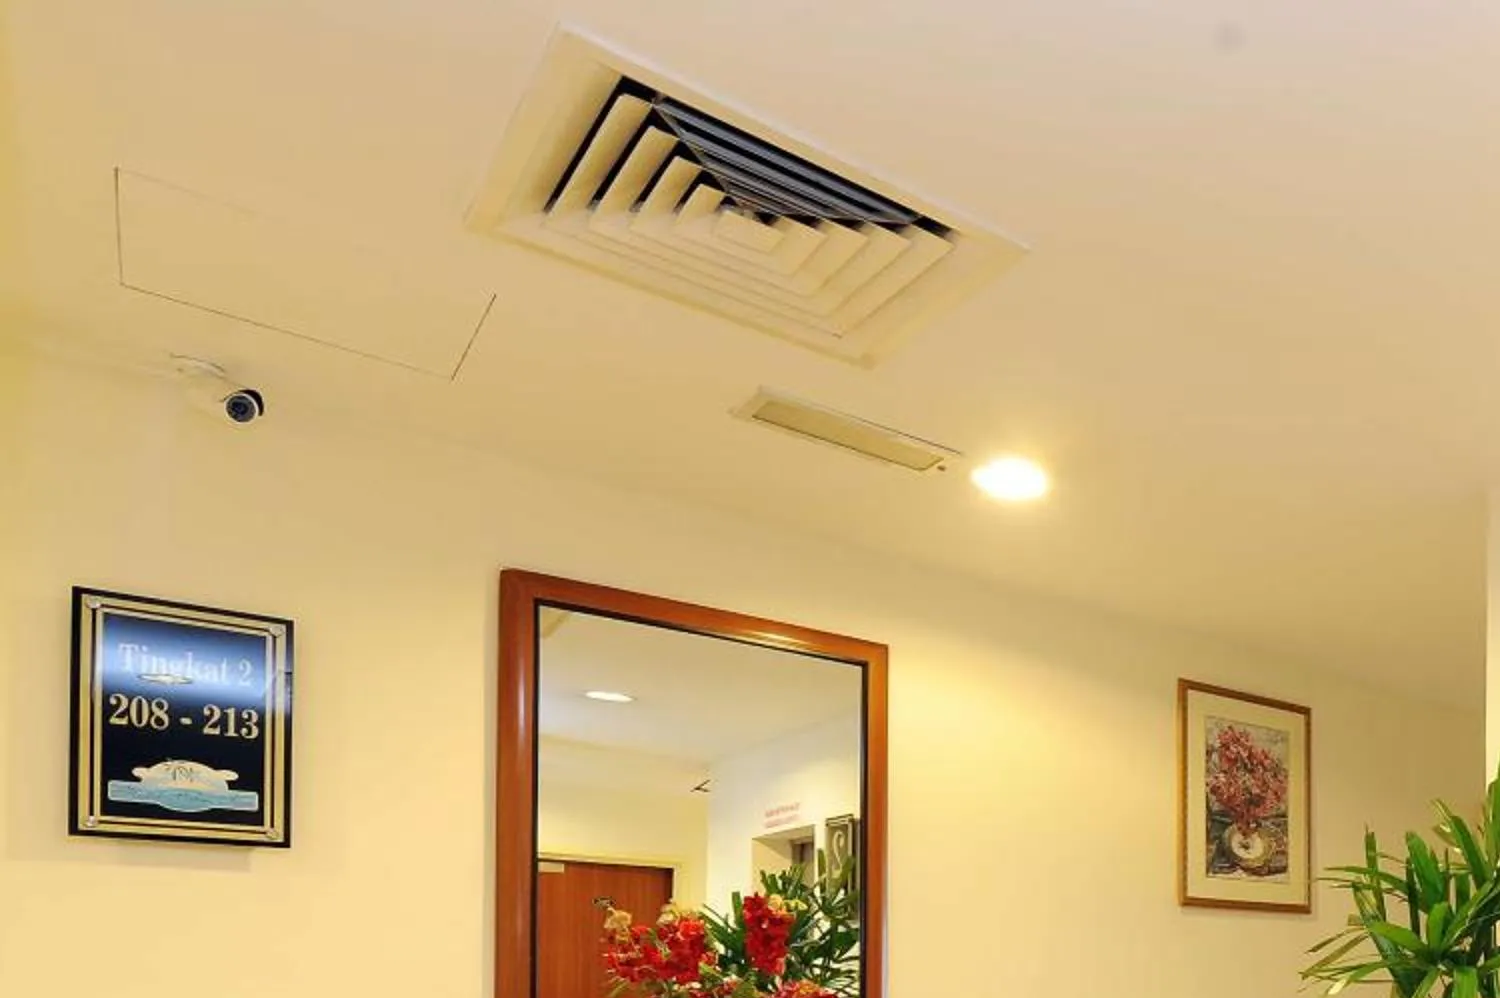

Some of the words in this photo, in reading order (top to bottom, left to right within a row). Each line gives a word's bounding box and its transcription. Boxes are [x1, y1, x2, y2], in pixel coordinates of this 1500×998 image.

[118, 643, 229, 685] Tingkat
[239, 658, 253, 686] 2
[109, 693, 170, 731] 208
[203, 704, 259, 740] 213
